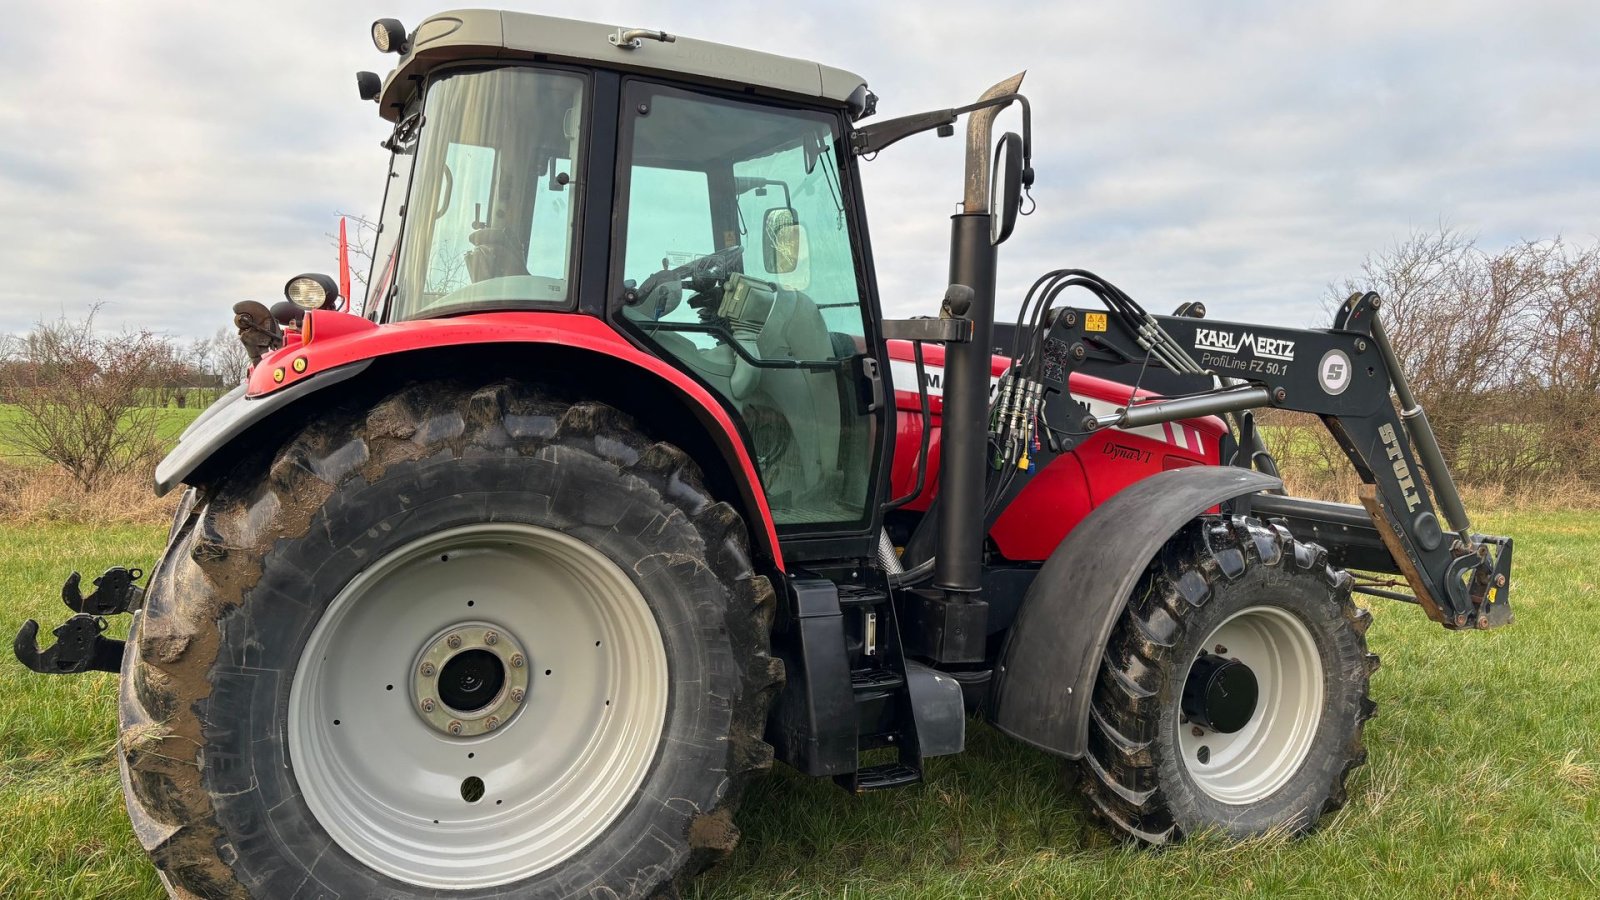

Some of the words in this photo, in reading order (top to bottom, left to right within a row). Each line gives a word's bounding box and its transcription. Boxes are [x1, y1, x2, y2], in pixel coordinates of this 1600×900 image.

[1195, 328, 1237, 351] KARL
[1236, 332, 1295, 360] MERTZ
[1201, 352, 1247, 370] ProfiLine
[1248, 359, 1265, 373] FZ
[1265, 362, 1288, 376] 50.1
[1377, 422, 1421, 513] STOLL
